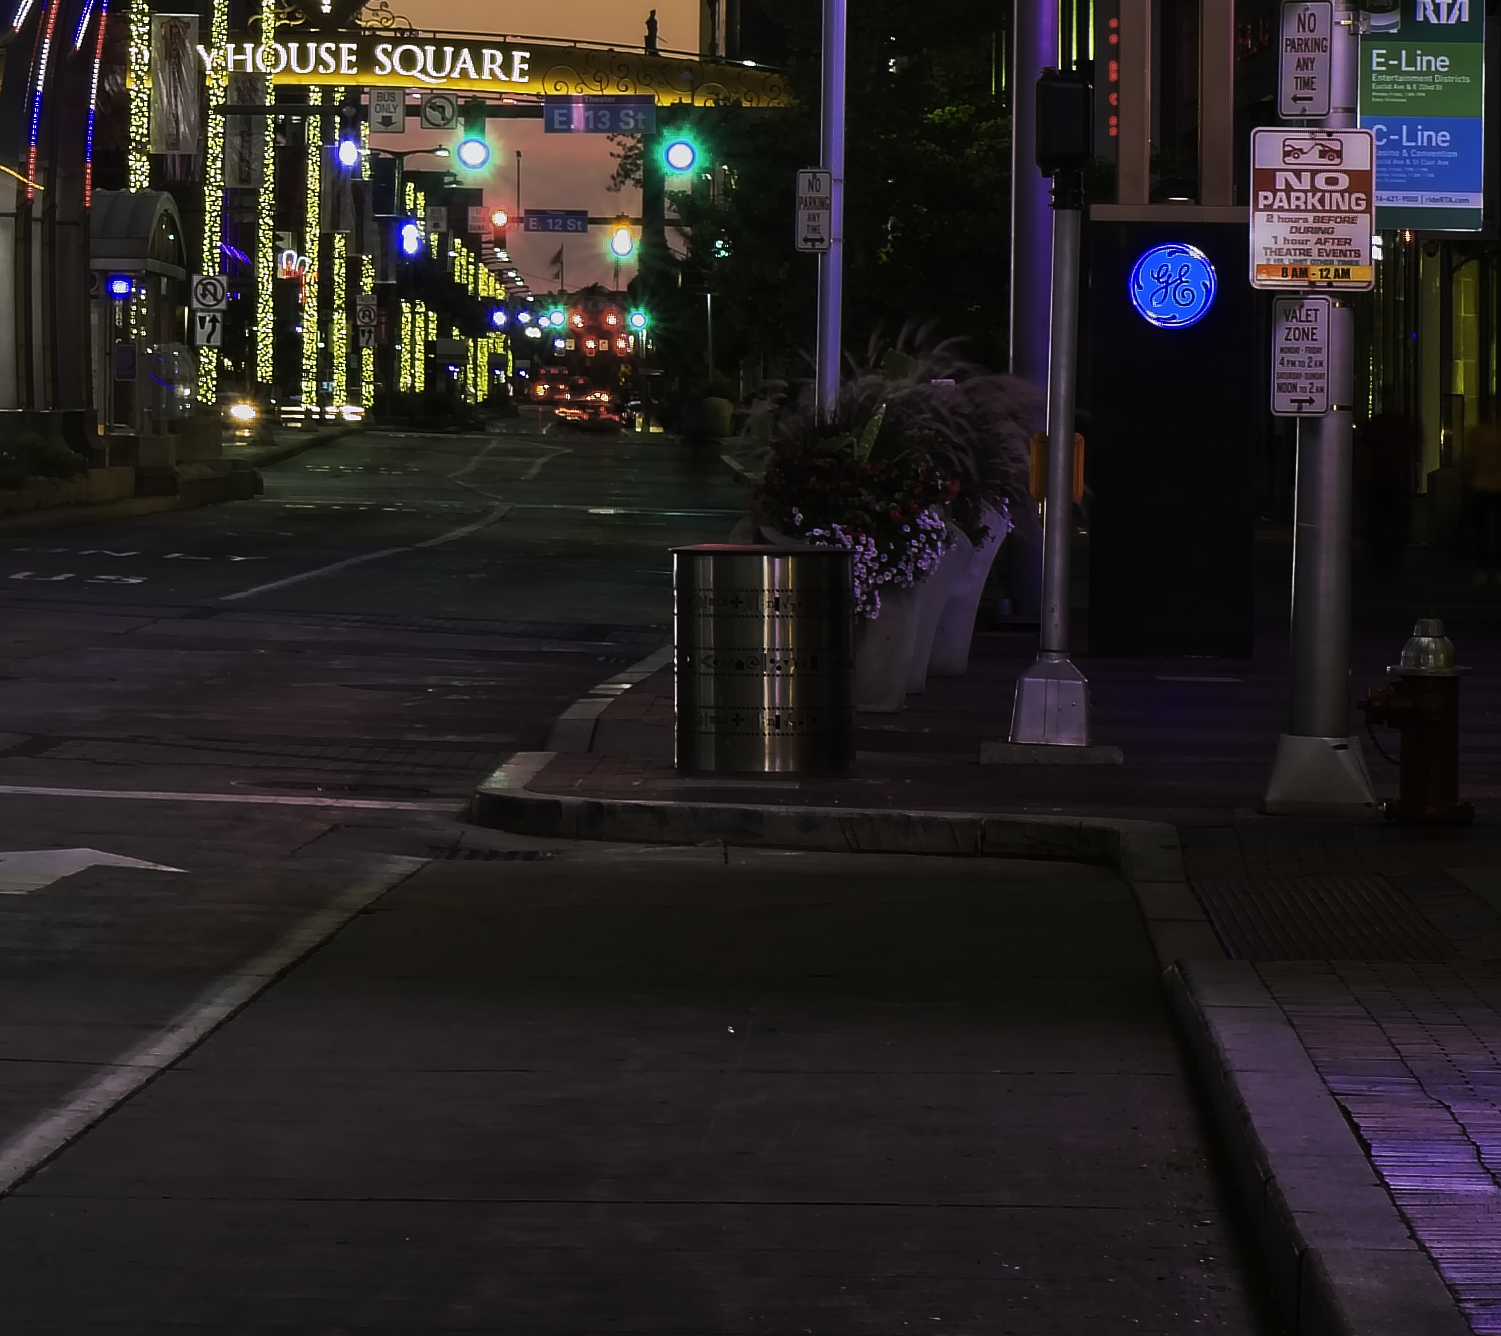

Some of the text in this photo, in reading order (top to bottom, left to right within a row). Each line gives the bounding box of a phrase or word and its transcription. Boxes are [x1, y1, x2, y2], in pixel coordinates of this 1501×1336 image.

[1297, 12, 1317, 34] NO
[1284, 37, 1329, 54] PARKING
[374, 42, 531, 84] SQUARE
[1295, 57, 1316, 72] ANY
[1371, 49, 1450, 72] E-Line
[1293, 76, 1318, 91] TIME
[1372, 73, 1471, 84] Entertainment Districts
[376, 91, 396, 103] BUS
[374, 102, 398, 114] ONLY
[584, 109, 612, 130] 13
[618, 109, 646, 130] St
[1372, 124, 1451, 147] C-Line
[1376, 149, 1400, 158] asino
[1411, 149, 1458, 158] Convention
[807, 177, 822, 193] NO
[1276, 171, 1350, 191] NO
[1258, 191, 1367, 211] PARKING
[528, 217, 583, 231] E. 12 St
[807, 213, 822, 223] ANY
[1265, 214, 1359, 225] 2 hours BEFORE
[1289, 225, 1335, 235] DURING
[1271, 236, 1352, 246] 1 hour AFTER
[1262, 247, 1361, 259] THEATRE EVENTS
[1291, 267, 1309, 278] AM
[1319, 268, 1331, 279] 12
[1333, 268, 1351, 279] AM
[1283, 308, 1320, 323] VALET
[1284, 327, 1319, 342] ZONE
[1278, 356, 1285, 367] 4
[1286, 359, 1296, 367] PM
[1307, 356, 1314, 368] 2
[1276, 381, 1298, 394] NOON
[1308, 382, 1315, 394] 2
